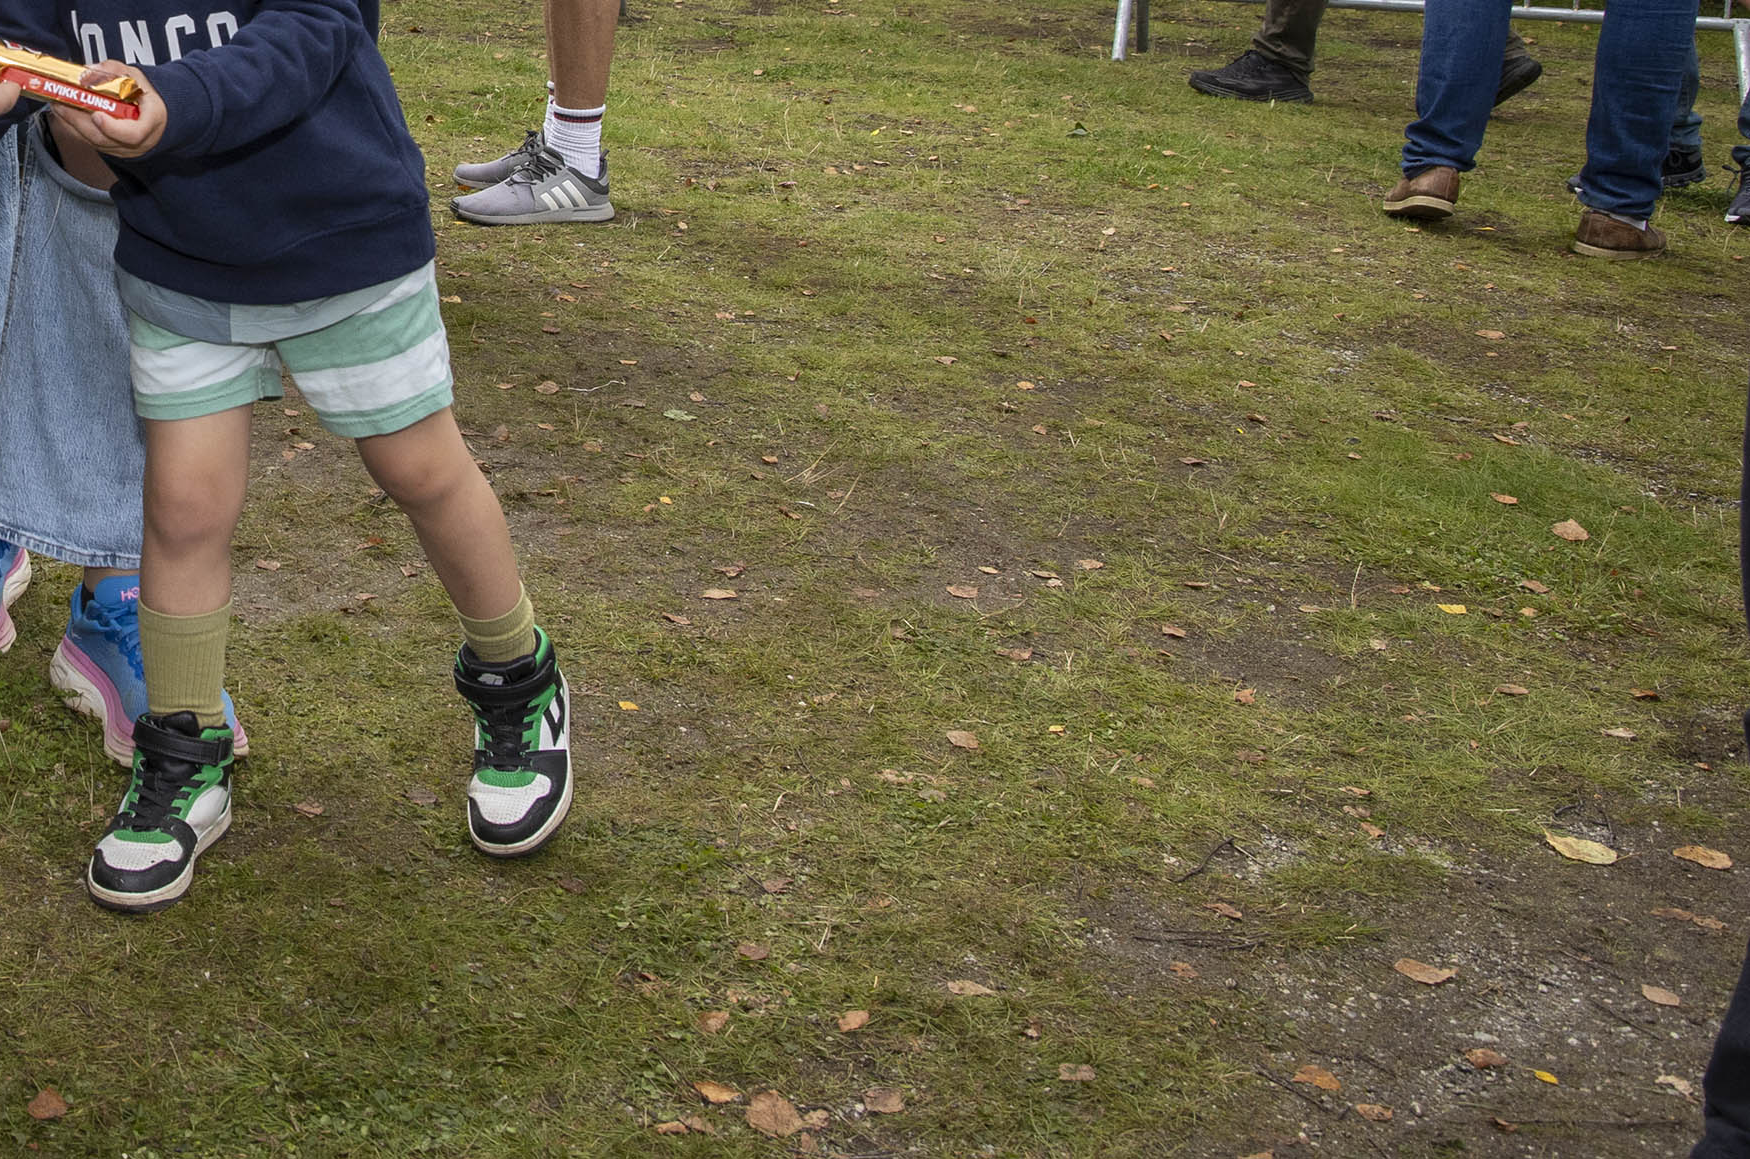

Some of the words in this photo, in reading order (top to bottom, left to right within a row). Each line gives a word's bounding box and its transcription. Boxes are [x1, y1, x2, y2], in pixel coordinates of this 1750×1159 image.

[43, 80, 78, 101] KVIKK
[80, 91, 117, 113] LUNSJ
[121, 586, 140, 602] HO
